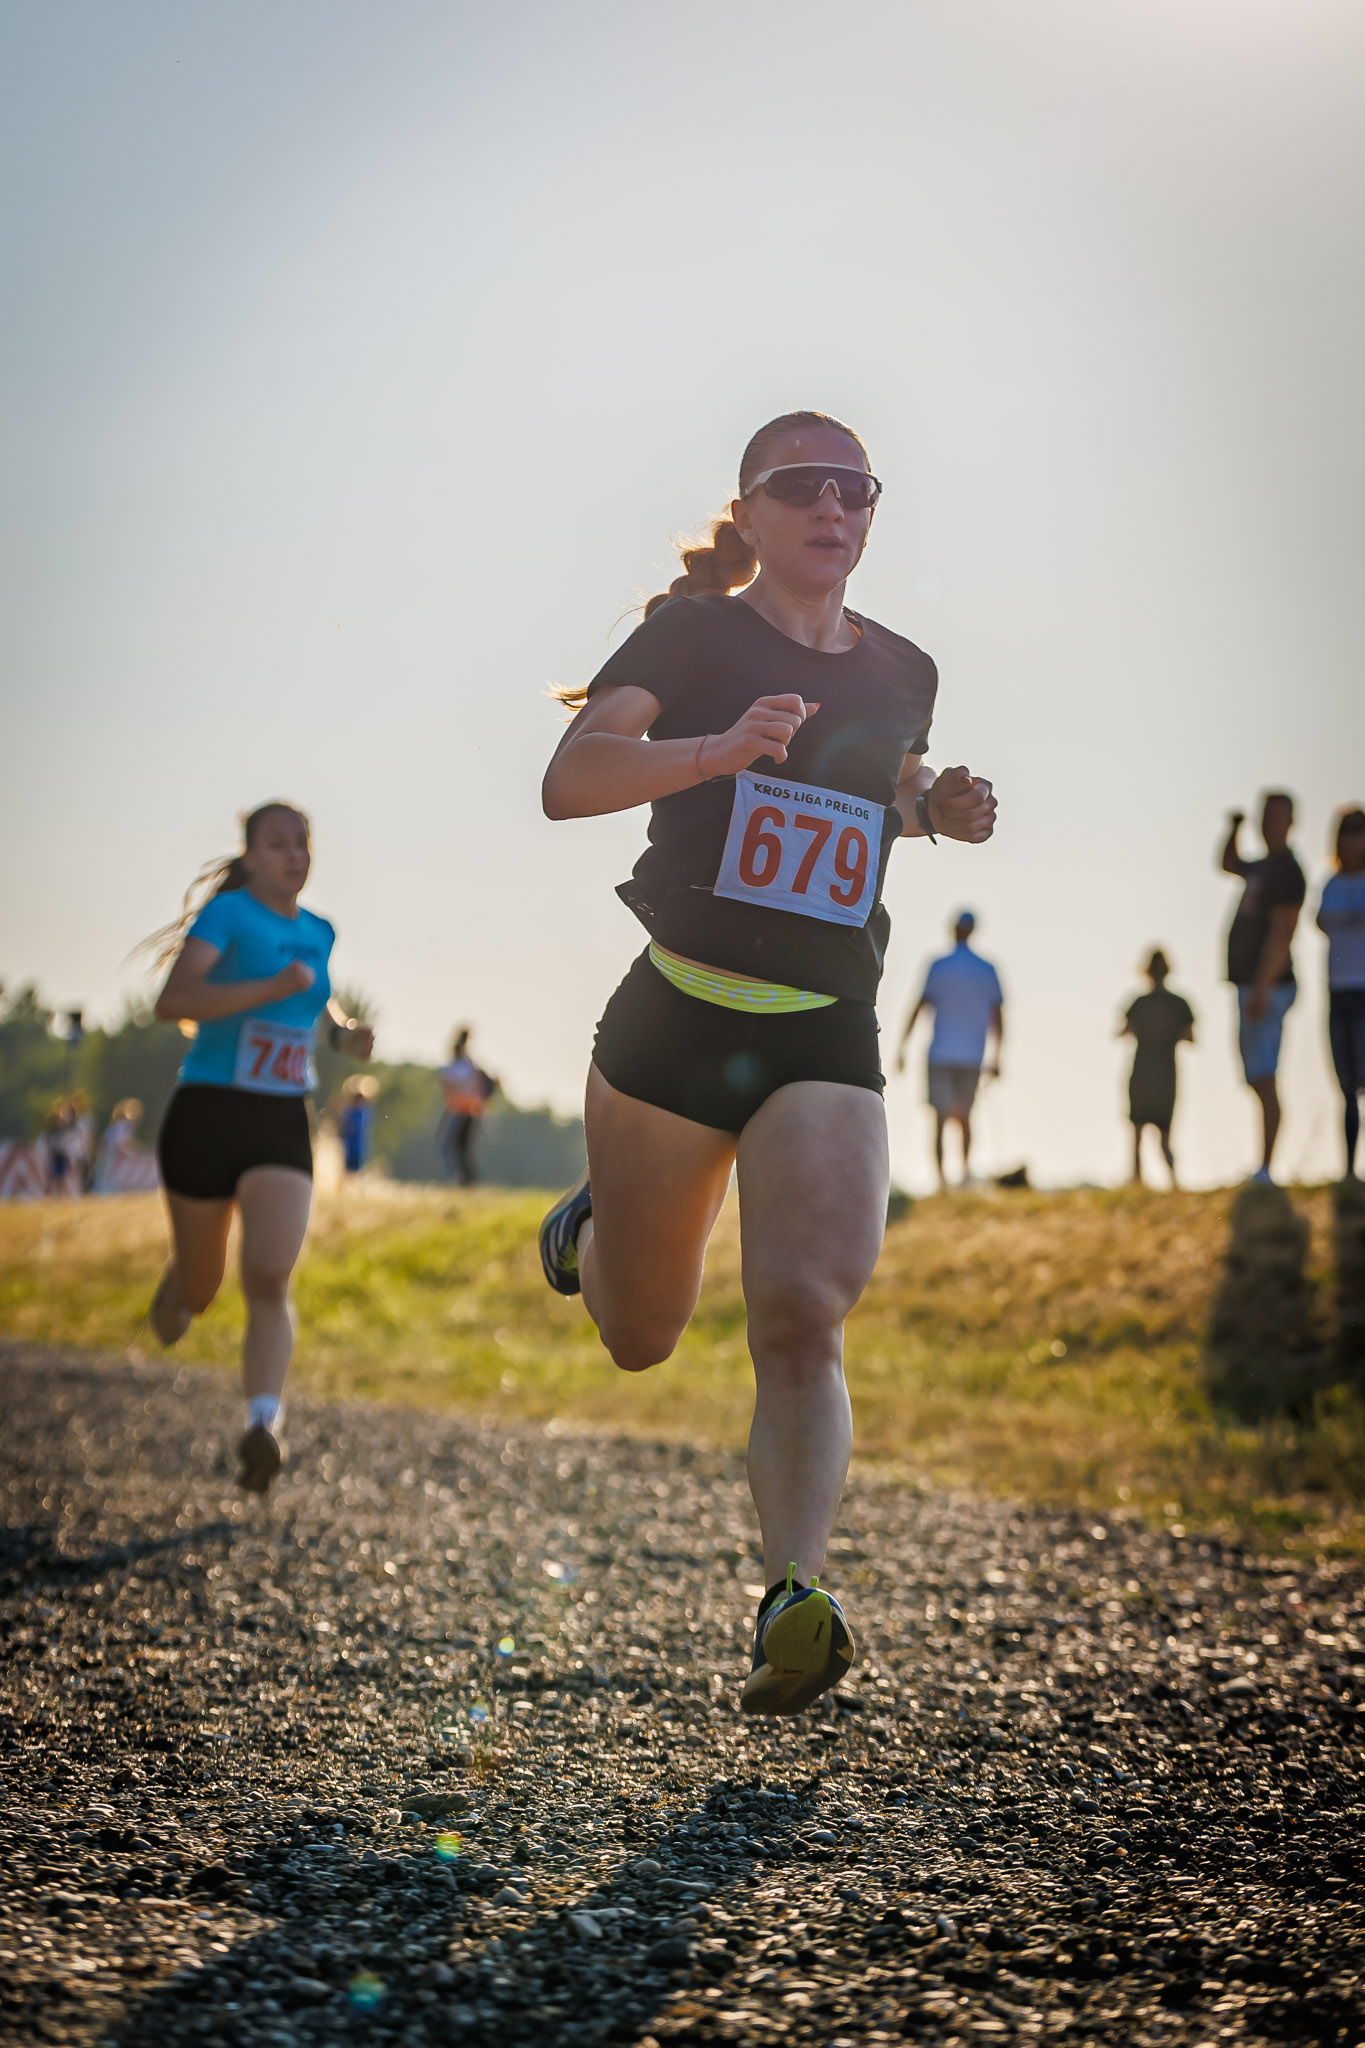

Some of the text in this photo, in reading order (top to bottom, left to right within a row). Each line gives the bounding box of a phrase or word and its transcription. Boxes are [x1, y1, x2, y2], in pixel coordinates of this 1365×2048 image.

[753, 782, 870, 820] KROS LIGA PRELOG
[738, 805, 869, 907] 679
